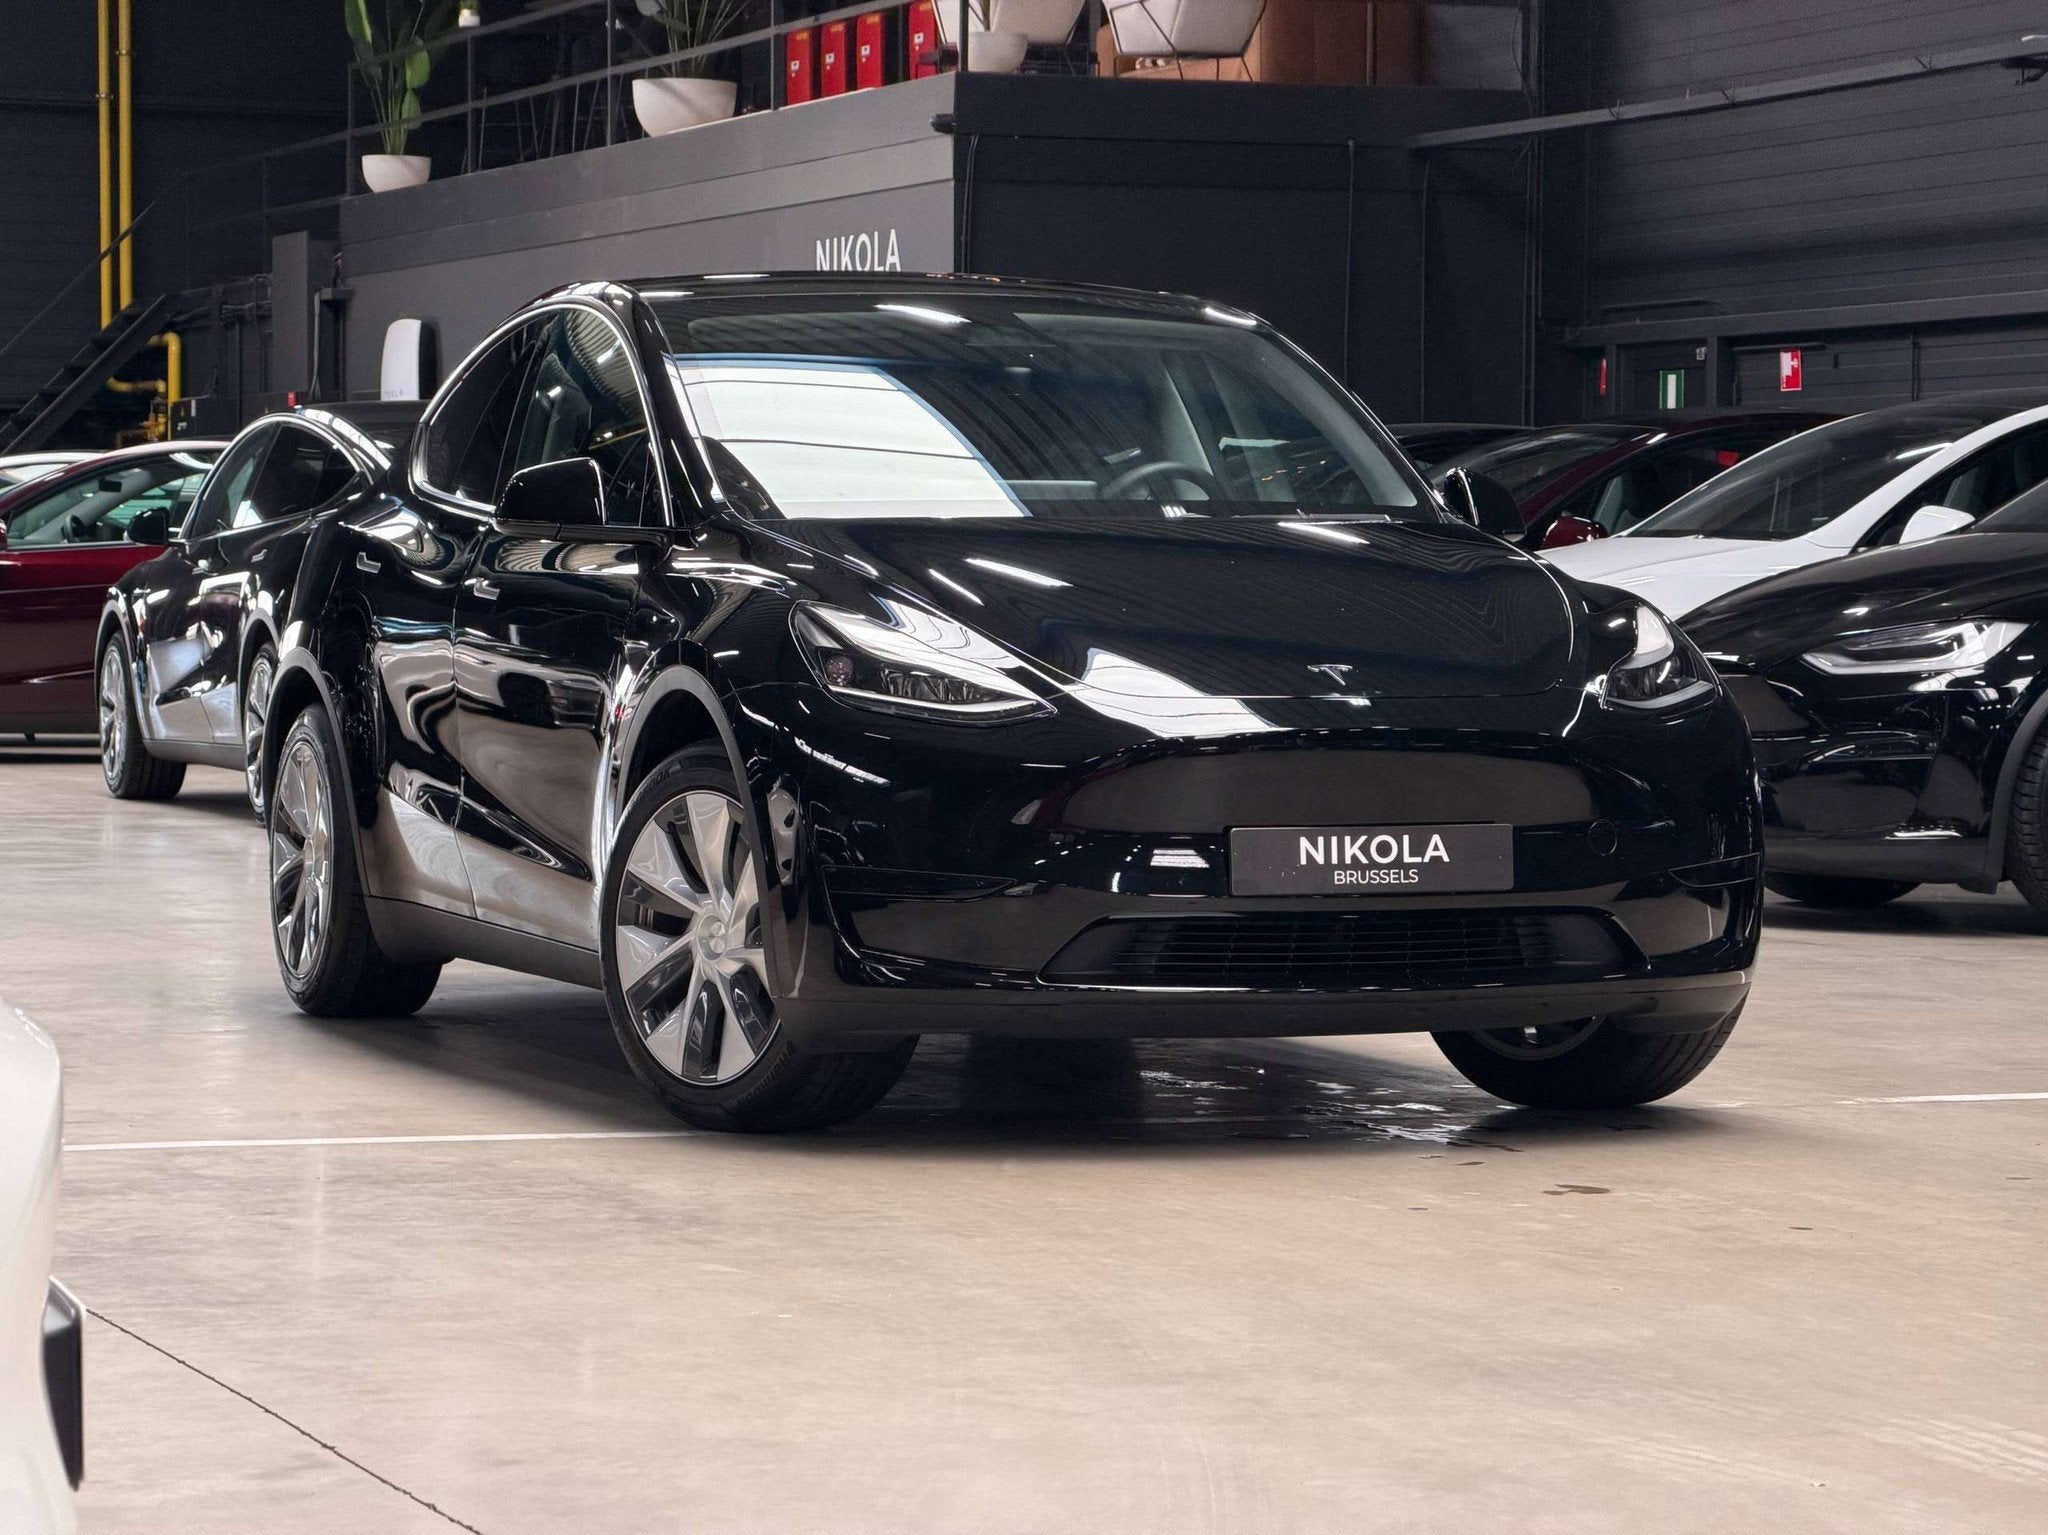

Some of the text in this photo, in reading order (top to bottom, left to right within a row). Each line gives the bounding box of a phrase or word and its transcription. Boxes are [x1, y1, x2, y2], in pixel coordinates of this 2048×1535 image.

[816, 228, 902, 272] NIKOLA
[1300, 834, 1450, 865] NIKOLA
[1333, 869, 1419, 885] BRUSSELS
